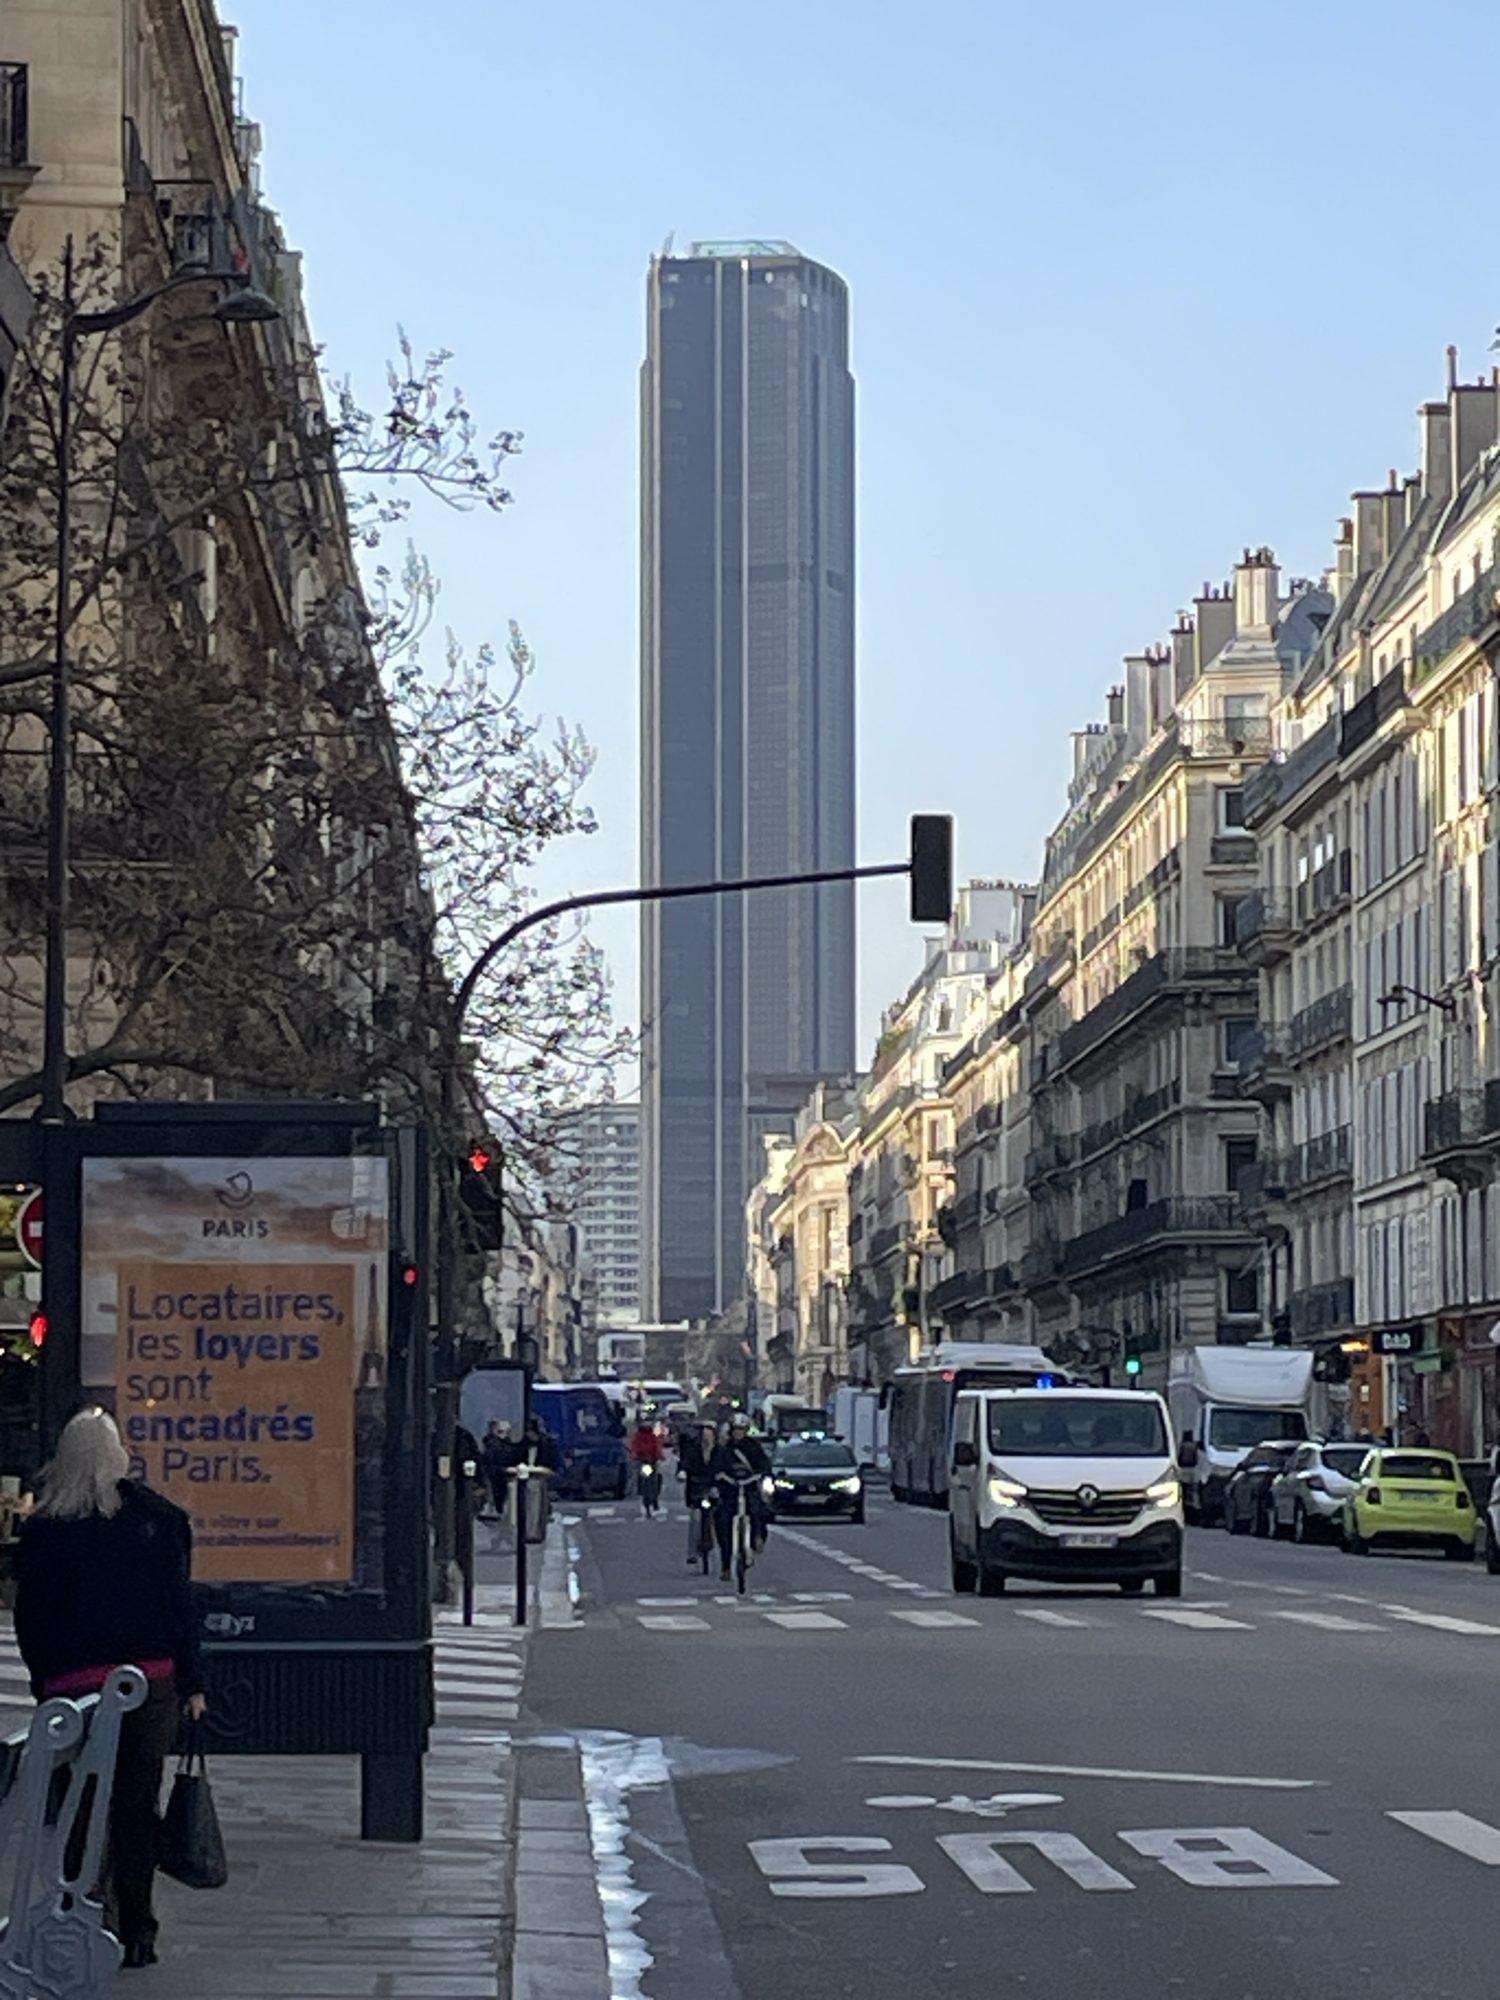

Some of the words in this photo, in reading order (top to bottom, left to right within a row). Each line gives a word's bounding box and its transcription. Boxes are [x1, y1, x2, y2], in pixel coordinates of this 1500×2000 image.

[203, 1219, 269, 1239] PARIS
[127, 1284, 345, 1325] Locataires,
[126, 1328, 182, 1360] les
[195, 1327, 321, 1369] loyers
[126, 1369, 214, 1402] sont
[127, 1405, 315, 1442] encadrés
[163, 1447, 272, 1483] Paris.
[747, 1827, 1341, 1898] BUS
